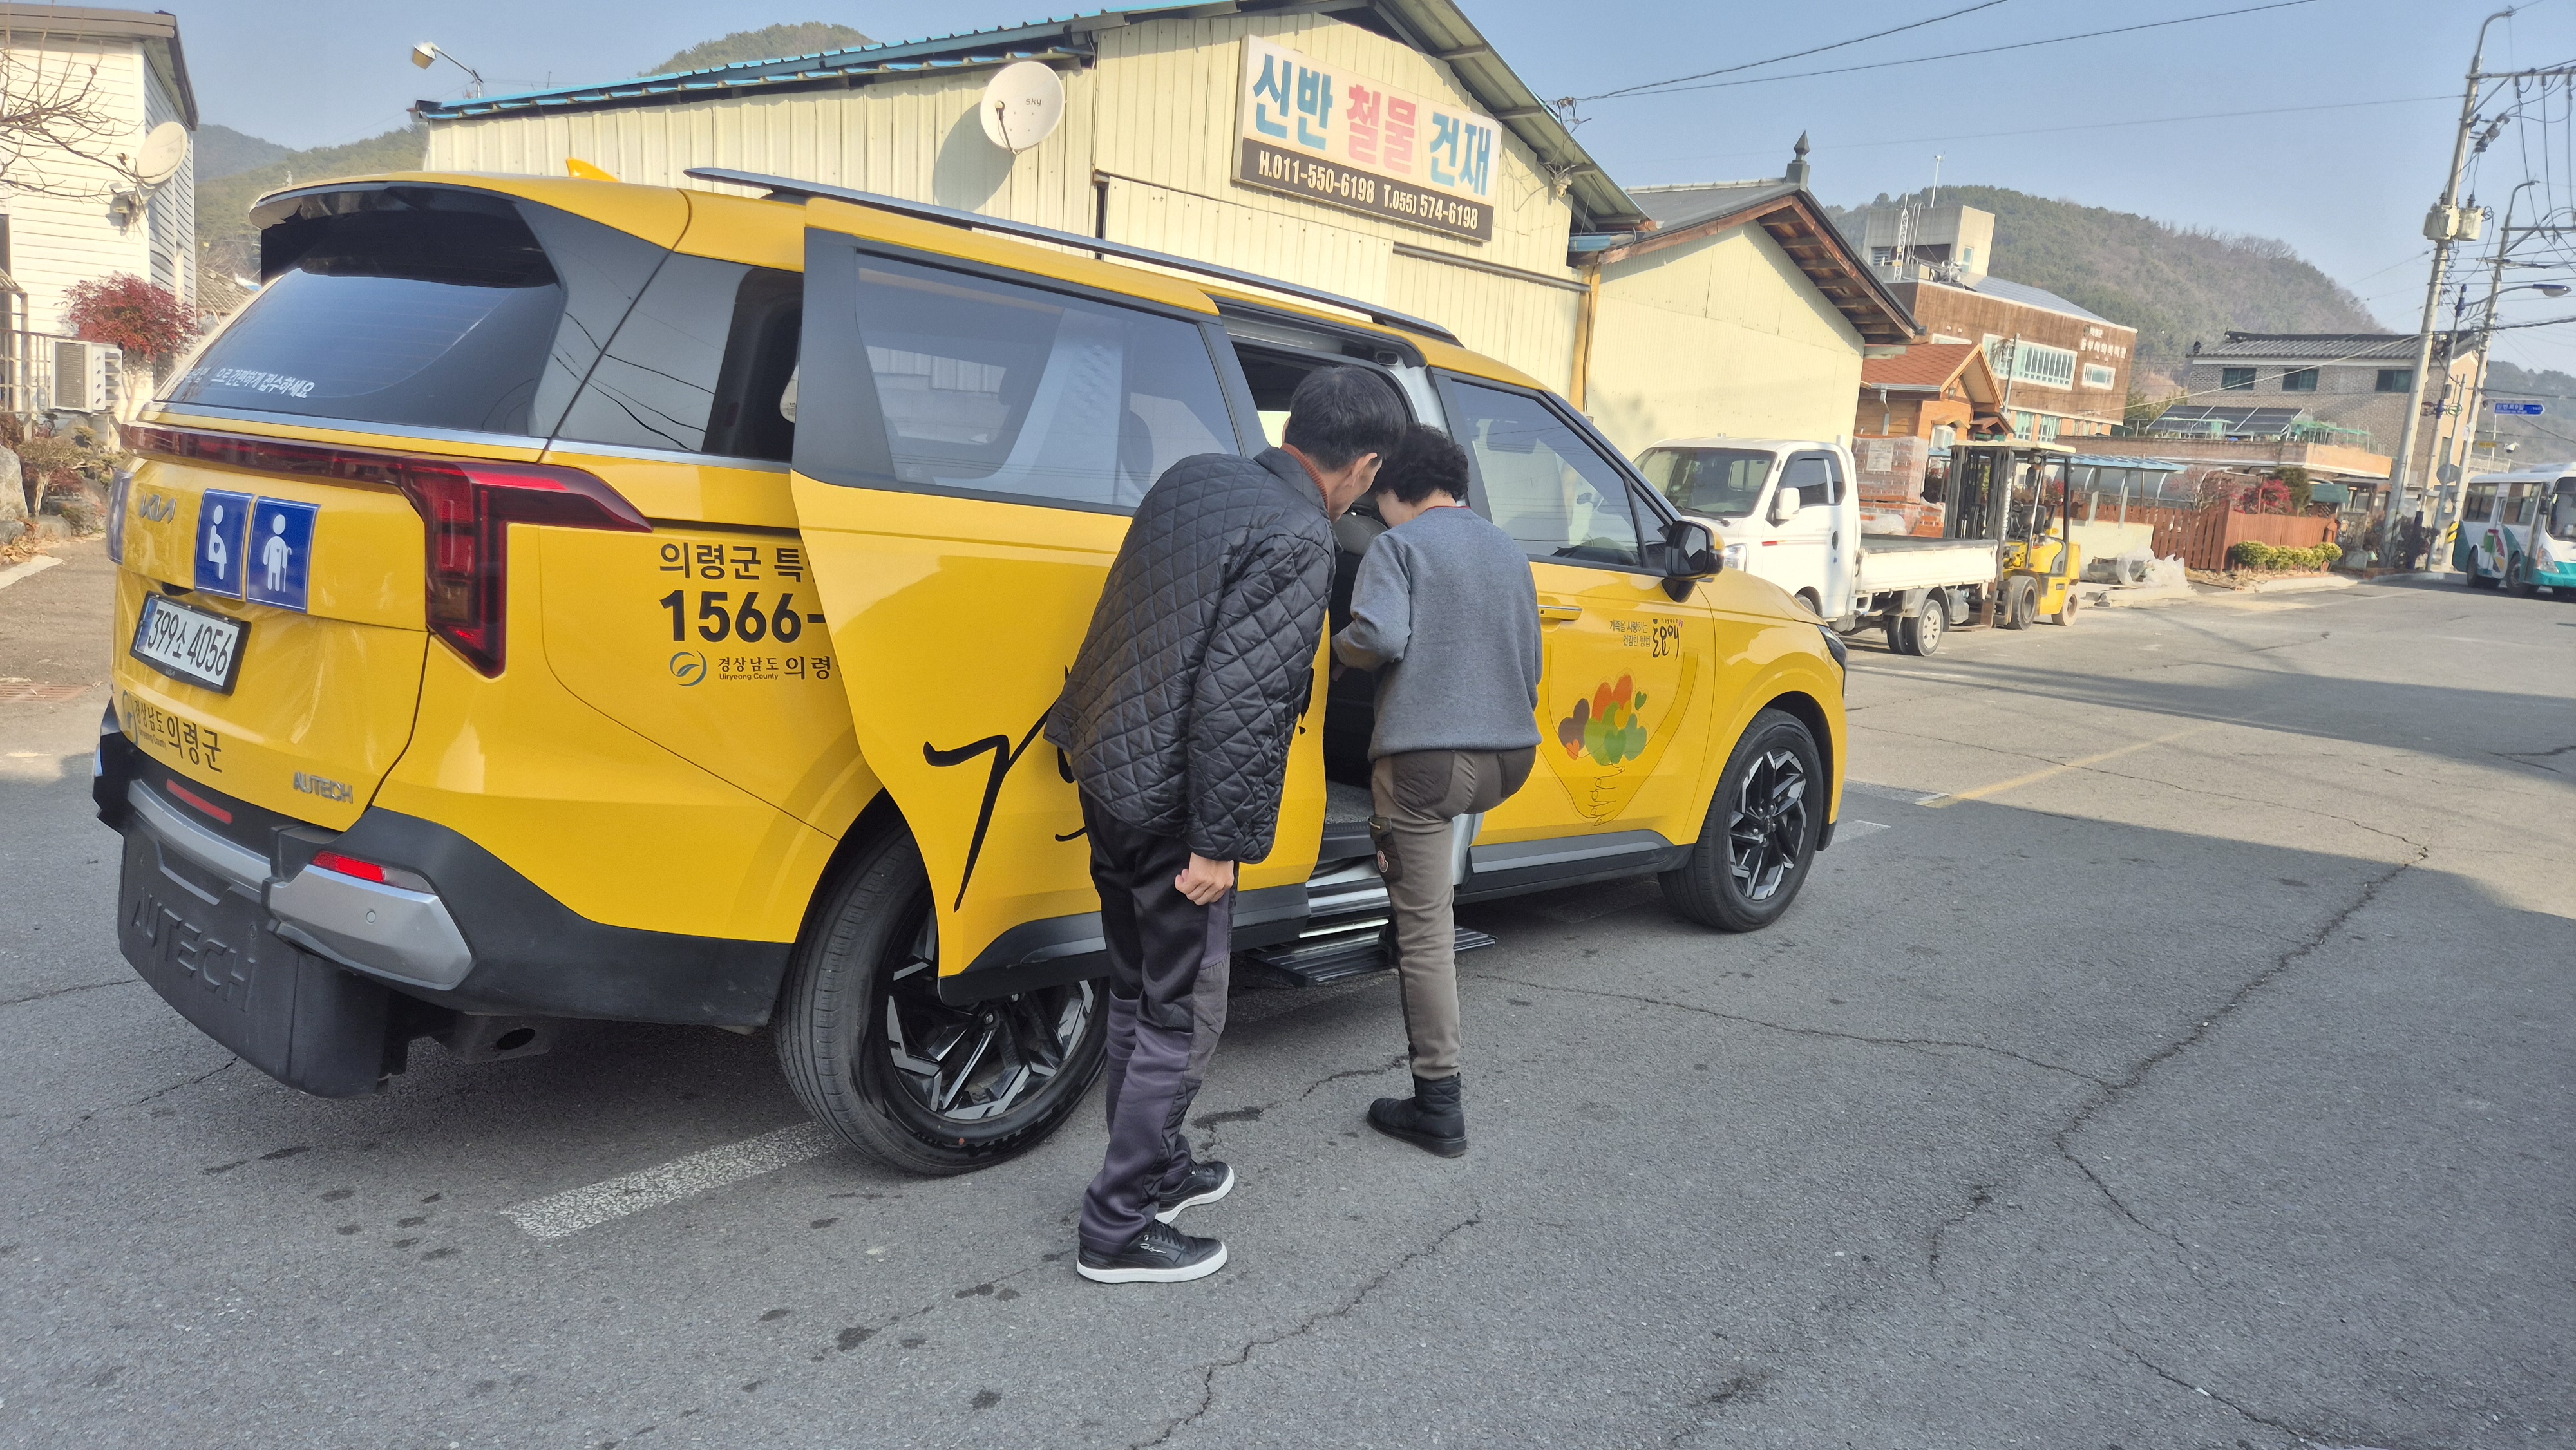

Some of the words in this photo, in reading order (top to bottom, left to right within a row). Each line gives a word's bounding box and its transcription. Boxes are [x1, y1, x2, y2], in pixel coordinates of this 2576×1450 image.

[1025, 98, 1042, 107] sky
[1253, 53, 1333, 151] 신반
[1346, 84, 1416, 174] 철물
[1430, 111, 1492, 196] 건재
[659, 542, 761, 580] 의령군
[774, 548, 814, 583] 특
[659, 590, 826, 643] 1566-
[1609, 619, 1625, 632] 가족을
[1627, 621, 1648, 634] 사랑하는
[187, 623, 233, 677] 4056
[1623, 634, 1639, 646] 건강한
[1640, 636, 1651, 647] 방법
[718, 657, 779, 673] 경상남도
[784, 655, 840, 681] 의령
[135, 699, 164, 733] 경상남도
[167, 716, 222, 773] 의령군
[293, 771, 354, 804] AUTECH
